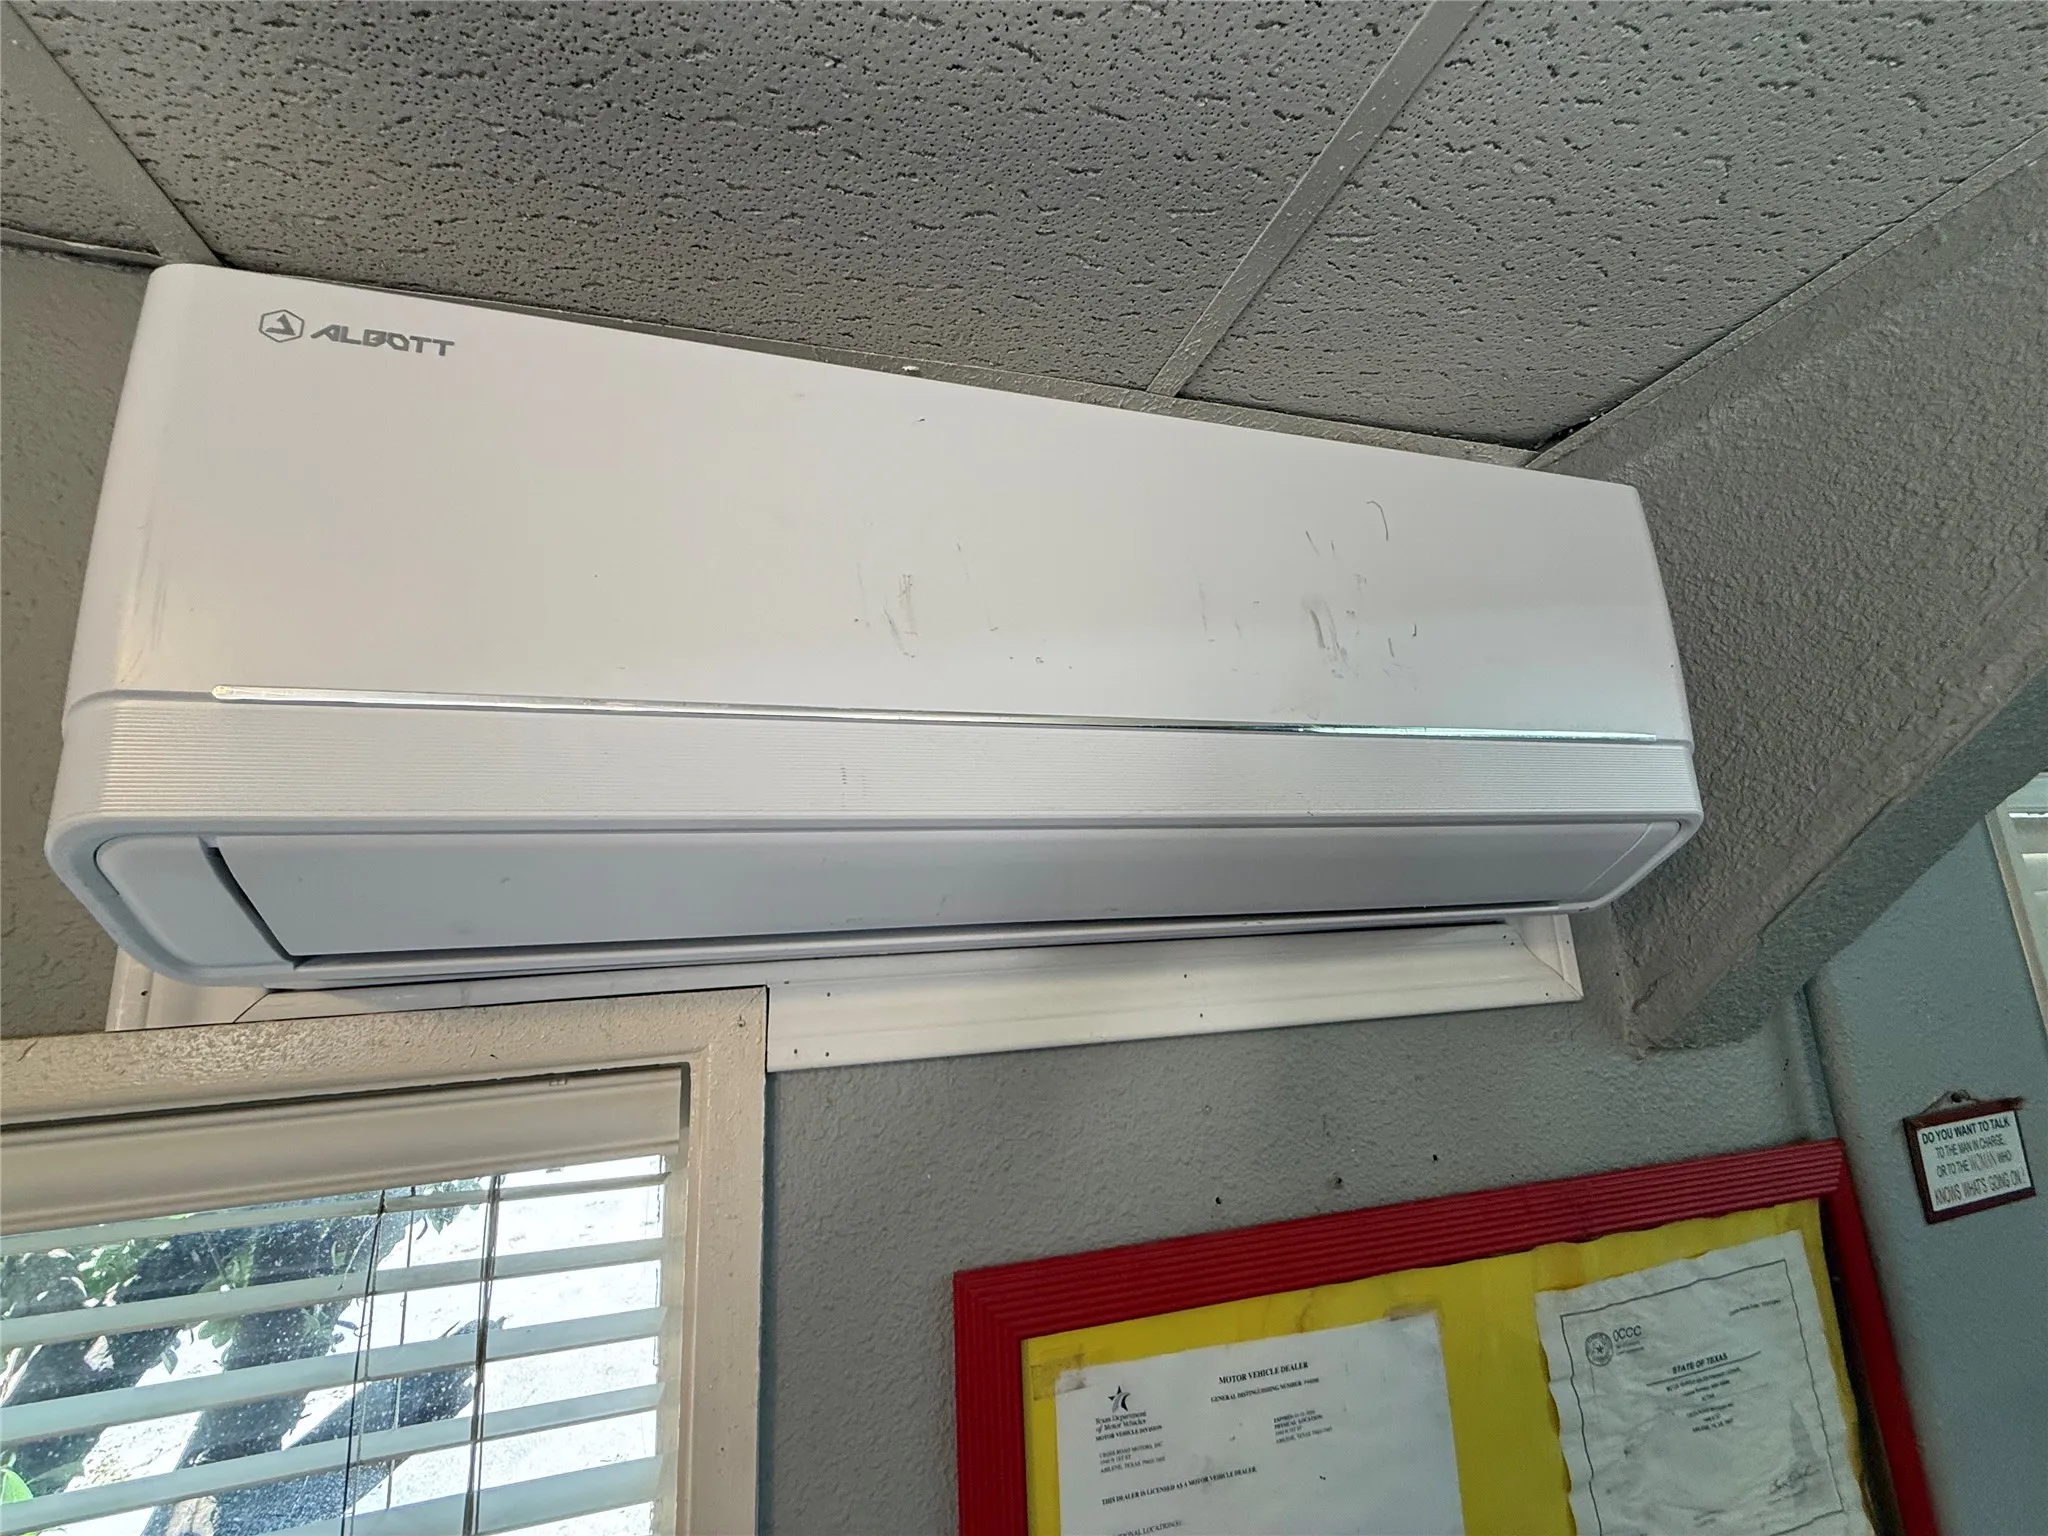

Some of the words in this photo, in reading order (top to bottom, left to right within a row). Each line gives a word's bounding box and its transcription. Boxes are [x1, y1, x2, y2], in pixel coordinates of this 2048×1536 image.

[311, 324, 454, 356] ALBOTT
[1922, 1131, 1935, 1144] DO
[1935, 1128, 1953, 1141] YOU
[1954, 1124, 1977, 1137] WANT
[1978, 1121, 1990, 1132] TO
[1990, 1116, 2011, 1129] TALK
[1935, 1146, 1945, 1159] TO
[1945, 1143, 1958, 1156] THE
[1958, 1141, 1973, 1153] MAN
[1972, 1139, 1980, 1150] IN
[1936, 1165, 1948, 1178] OR
[1947, 1162, 1956, 1175] TO
[1956, 1159, 1970, 1173] THE
[1934, 1184, 1962, 1205] KNOWS
[1613, 1325, 1642, 1342] OCCC
[1218, 1373, 1247, 1384] MOTOR
[1248, 1367, 1279, 1379] VEHICLE
[1280, 1361, 1309, 1373] DEALER
[1672, 1361, 1694, 1374] STATE
[1695, 1359, 1705, 1369] OF
[1706, 1352, 1728, 1364] TEXAS
[1210, 1394, 1237, 1403] GENERAL
[1101, 1496, 1116, 1506] THIS
[1116, 1491, 1140, 1503] DEALER
[1147, 1484, 1175, 1496] LICENSED
[1188, 1476, 1209, 1487] MOTOR
[1209, 1471, 1234, 1482] VEHICLE
[1234, 1466, 1257, 1477] DEALER
